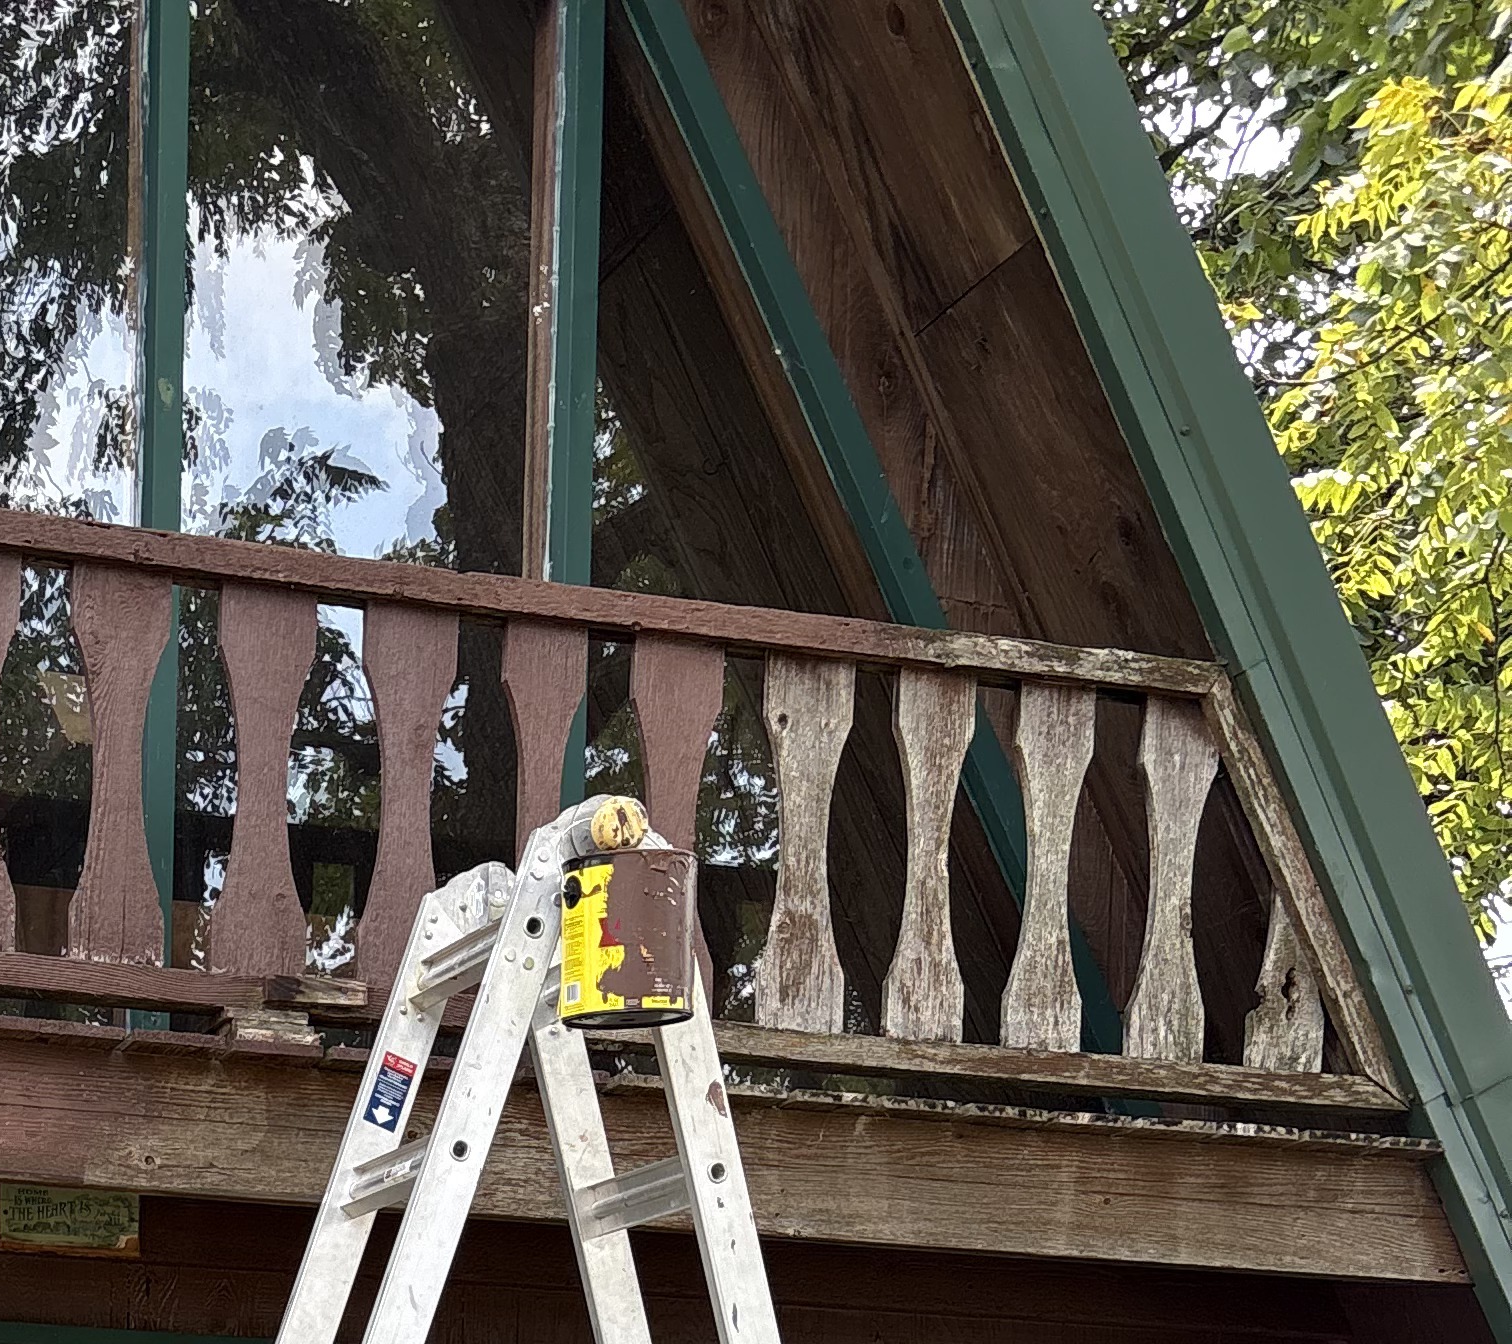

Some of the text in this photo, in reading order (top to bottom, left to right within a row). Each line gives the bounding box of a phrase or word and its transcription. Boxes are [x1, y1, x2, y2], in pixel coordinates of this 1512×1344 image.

[17, 1188, 49, 1196] HOME
[14, 1195, 22, 1205] IS
[8, 1206, 33, 1221] THE
[37, 1201, 76, 1220] HEART
